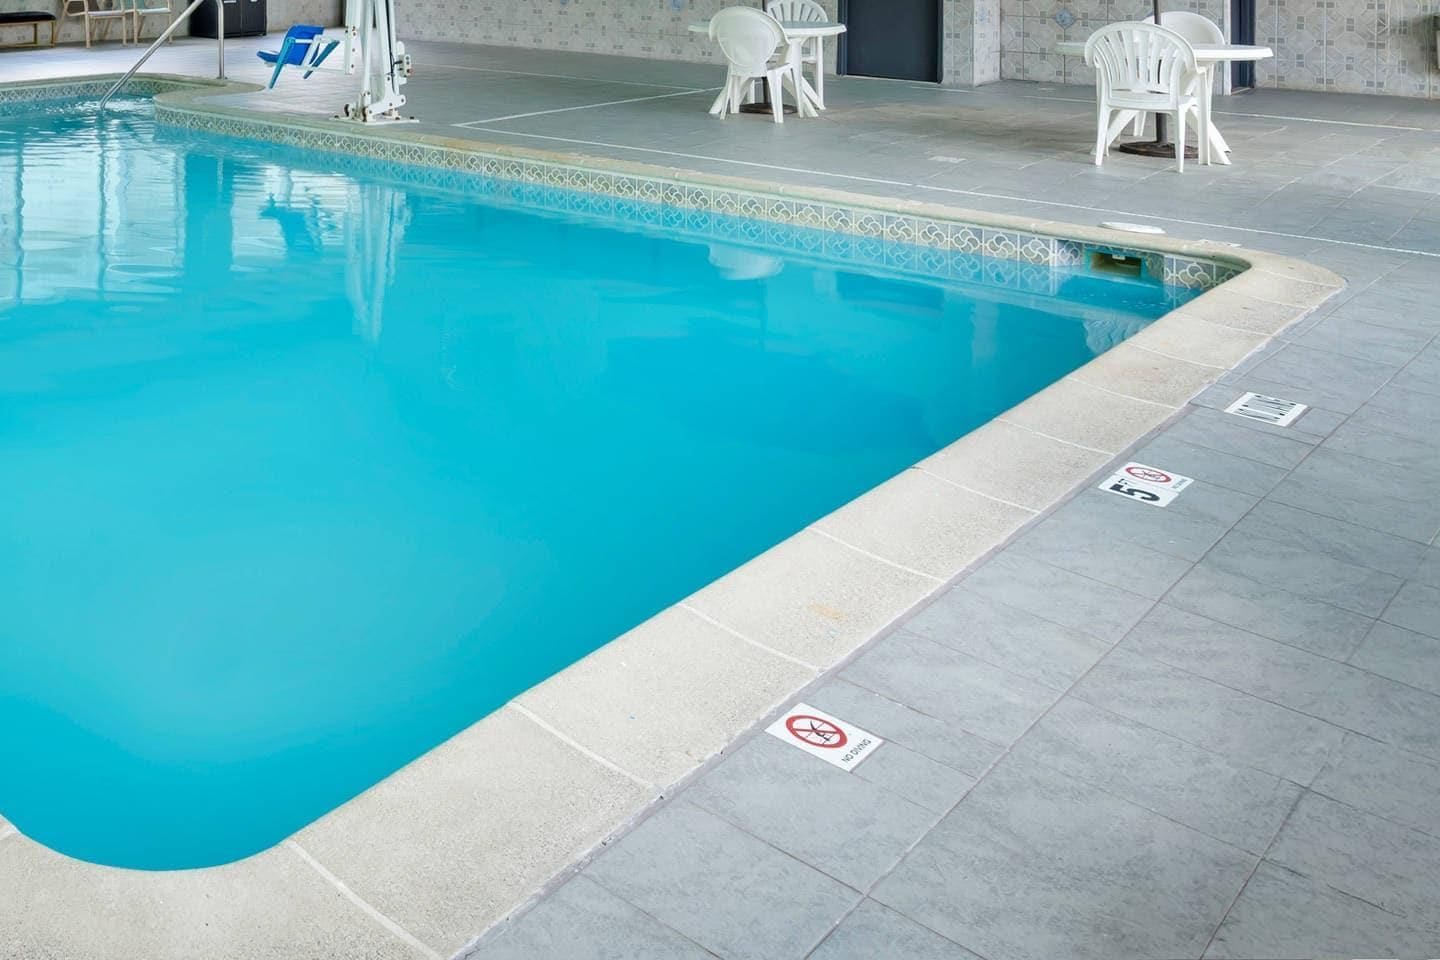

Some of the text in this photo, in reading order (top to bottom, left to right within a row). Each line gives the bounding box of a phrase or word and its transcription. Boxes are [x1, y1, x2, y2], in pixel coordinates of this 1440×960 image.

[1109, 483, 1160, 501] 5
[841, 739, 872, 762] NO DIVING
